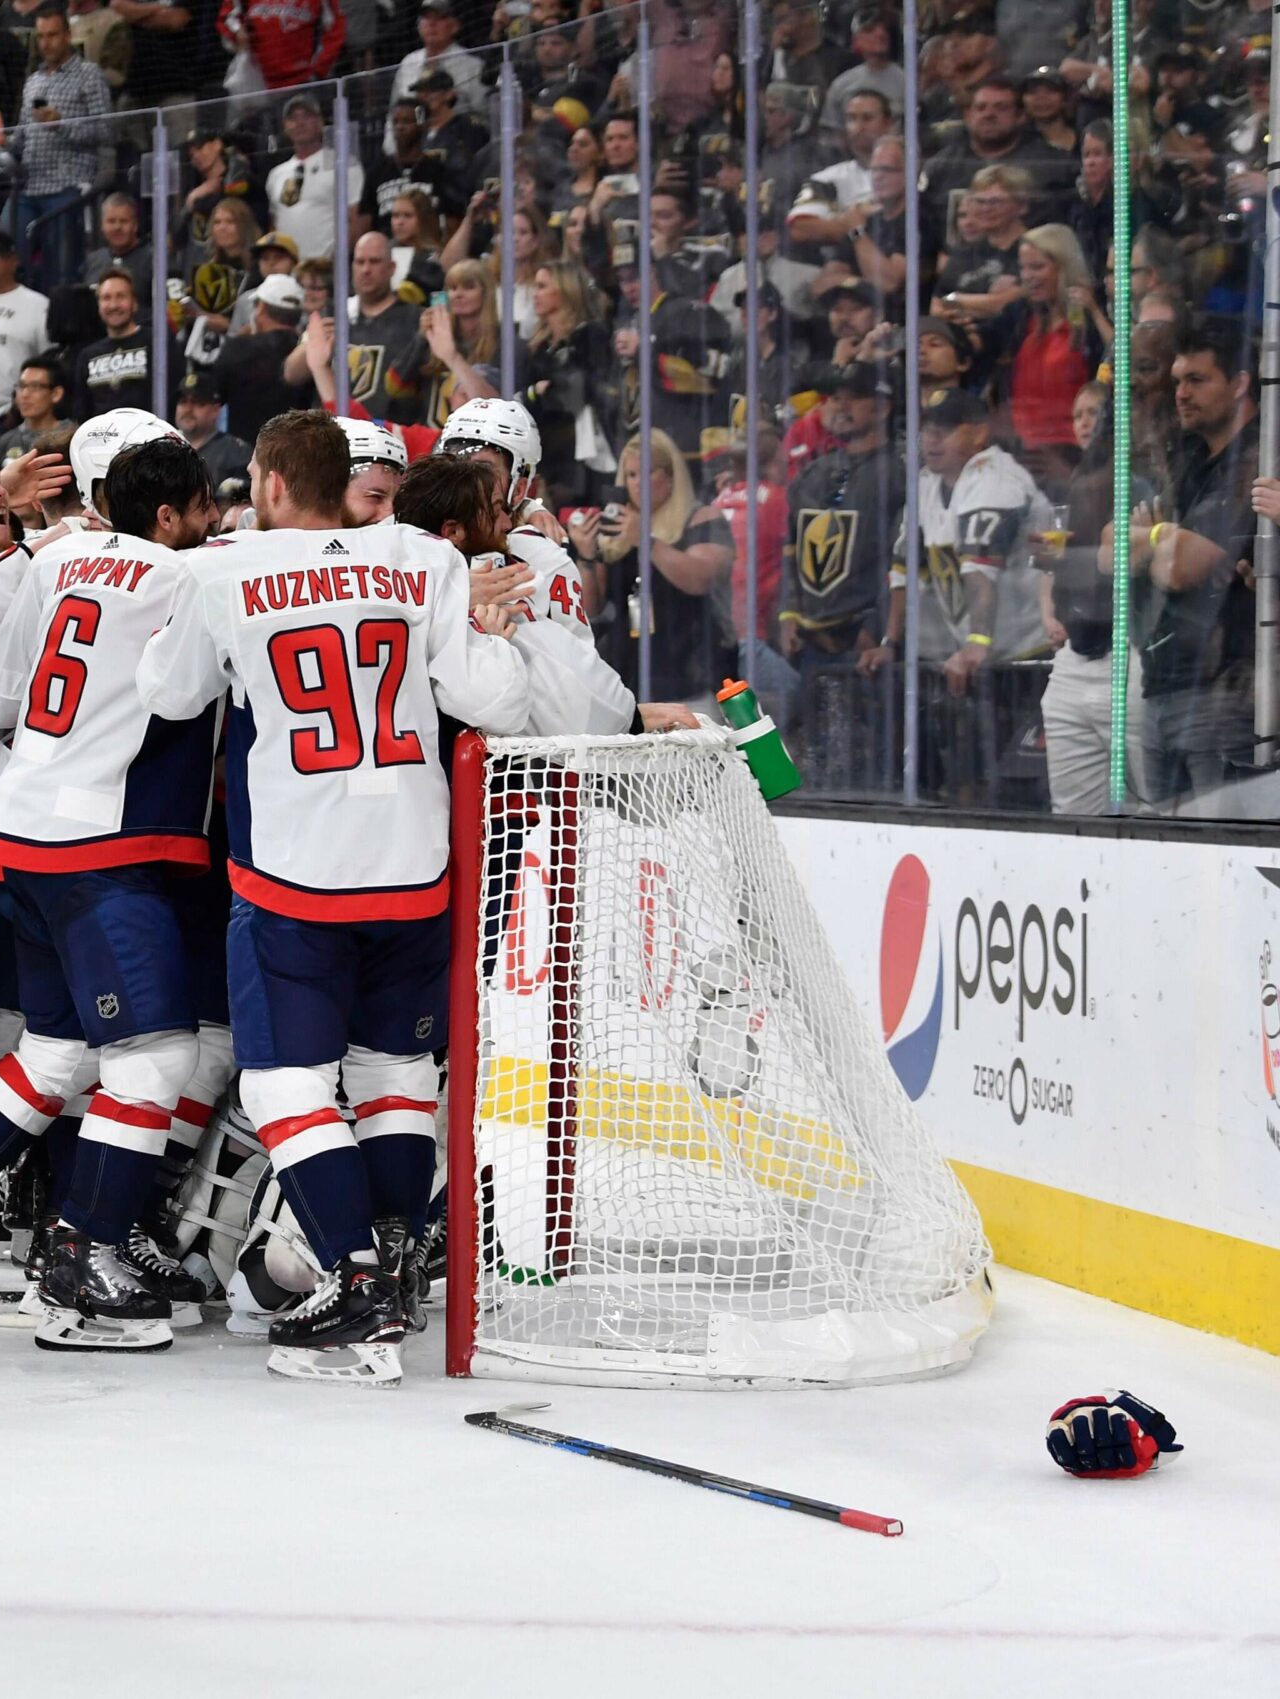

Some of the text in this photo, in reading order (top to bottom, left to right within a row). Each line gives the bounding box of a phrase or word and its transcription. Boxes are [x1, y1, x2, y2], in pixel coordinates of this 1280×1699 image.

[87, 349, 147, 376] VEGAS
[964, 510, 1002, 546] 17
[321, 547, 350, 556] adidas
[54, 555, 155, 596] KEMPNY
[240, 564, 428, 618] KUZNETSOV
[24, 593, 103, 739] 6
[267, 617, 428, 776] 92
[953, 878, 1089, 1043] pepsi
[1031, 1075, 1073, 1118] SUGAR
